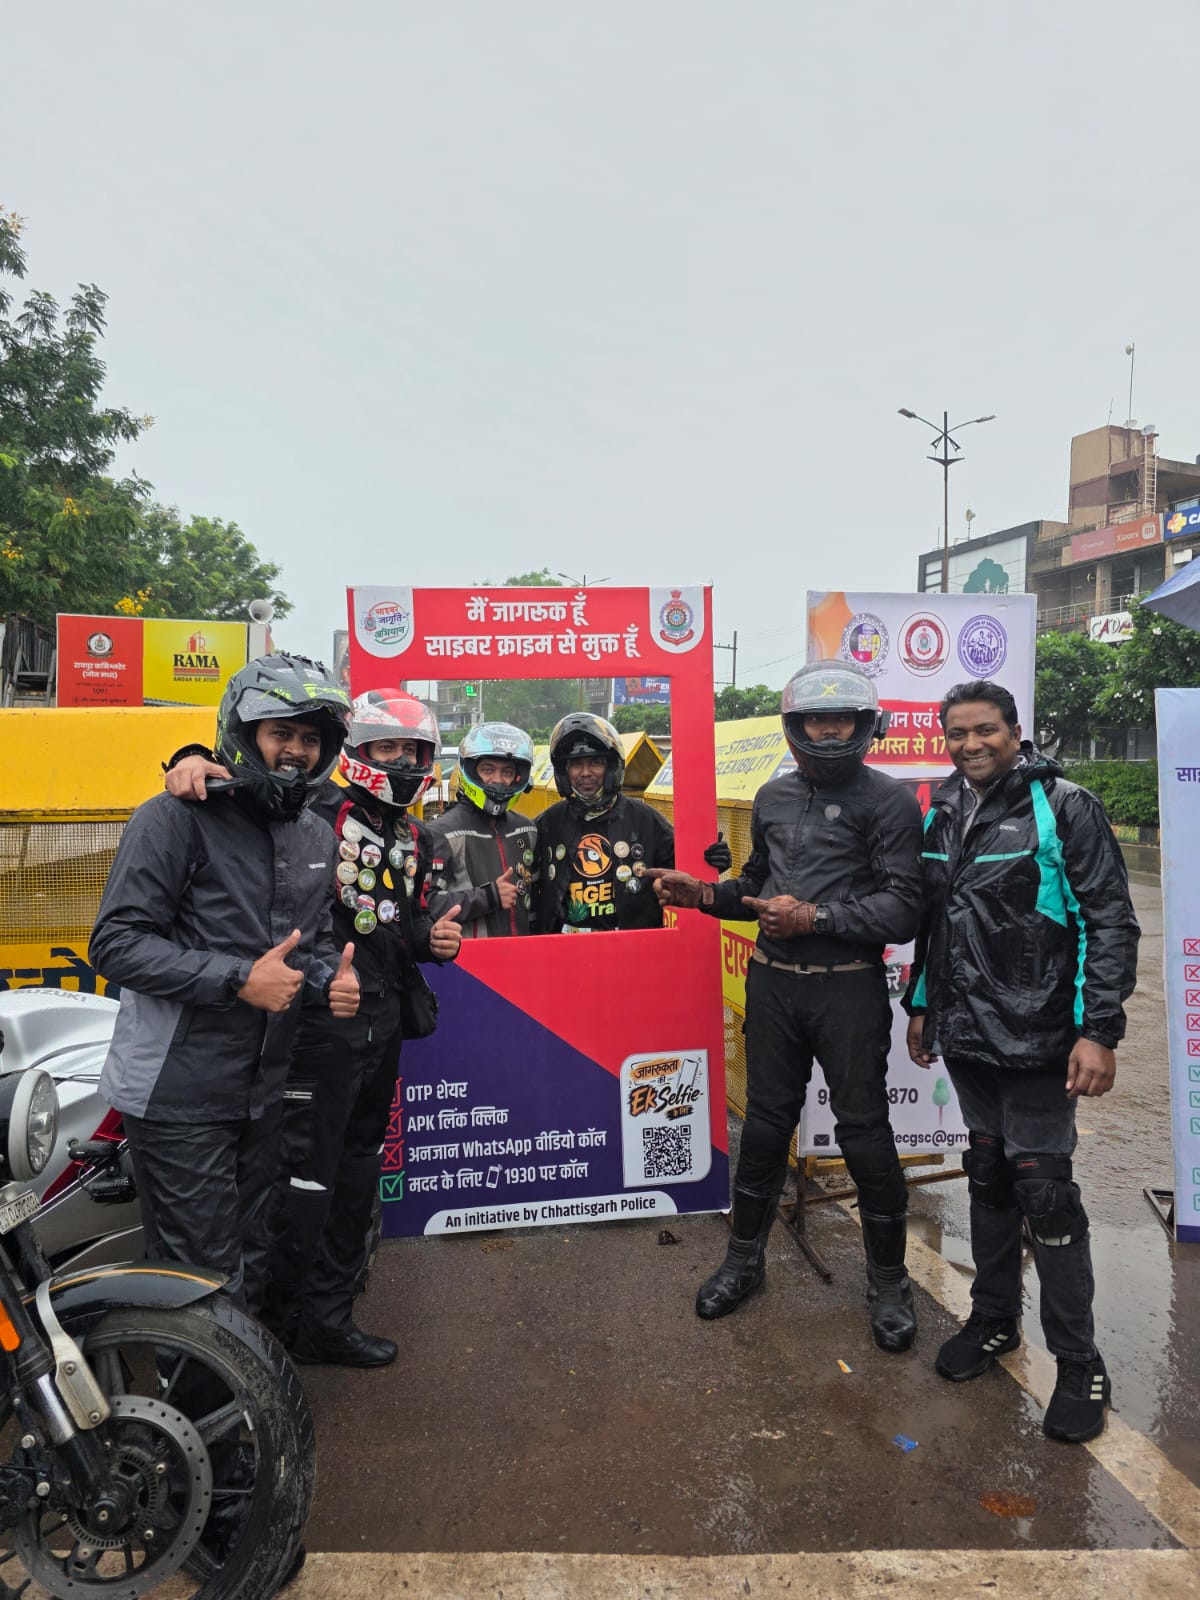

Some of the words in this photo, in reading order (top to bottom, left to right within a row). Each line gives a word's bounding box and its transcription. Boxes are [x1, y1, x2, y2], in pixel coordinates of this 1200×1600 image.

[375, 606, 399, 616] साइबर
[465, 596, 489, 622] मैं
[490, 602, 568, 622] जागरूक
[571, 591, 590, 626] हूँ
[374, 625, 405, 638] अभियान
[424, 636, 492, 658] साइबर
[495, 635, 554, 657] क्राइम
[557, 628, 578, 655] से
[580, 634, 621, 661] मुक्त
[623, 623, 641, 658] हूँ
[173, 654, 219, 668] RAMA
[912, 708, 933, 728] एवं
[912, 732, 926, 755] से
[570, 881, 615, 909] TIGE
[588, 902, 616, 917] Tra
[722, 928, 756, 978] राय
[406, 1085, 432, 1102] OTP
[436, 1079, 468, 1099] शेयर
[629, 1086, 657, 1116] Ek
[654, 1083, 701, 1113] Selfie
[407, 1115, 435, 1132] APK
[438, 1107, 468, 1129] लिंक
[470, 1106, 509, 1127] क्लिक
[408, 1143, 460, 1162] अनजान
[462, 1138, 532, 1158] WhatsApp
[534, 1129, 575, 1151] वीडियो
[577, 1127, 607, 1149] कॉल
[894, 1130, 968, 1146] ecgsc@gm
[408, 1175, 439, 1192] मदद
[441, 1169, 454, 1190] के
[456, 1168, 484, 1189] लिए
[505, 1166, 536, 1184] 1930
[538, 1164, 558, 1181] पर
[560, 1159, 589, 1180] कॉल
[445, 1215, 461, 1228] An
[465, 1209, 520, 1226] initiative
[523, 1207, 538, 1222] by
[541, 1199, 618, 1219] Chhattisgarh
[621, 1197, 656, 1212] Police
